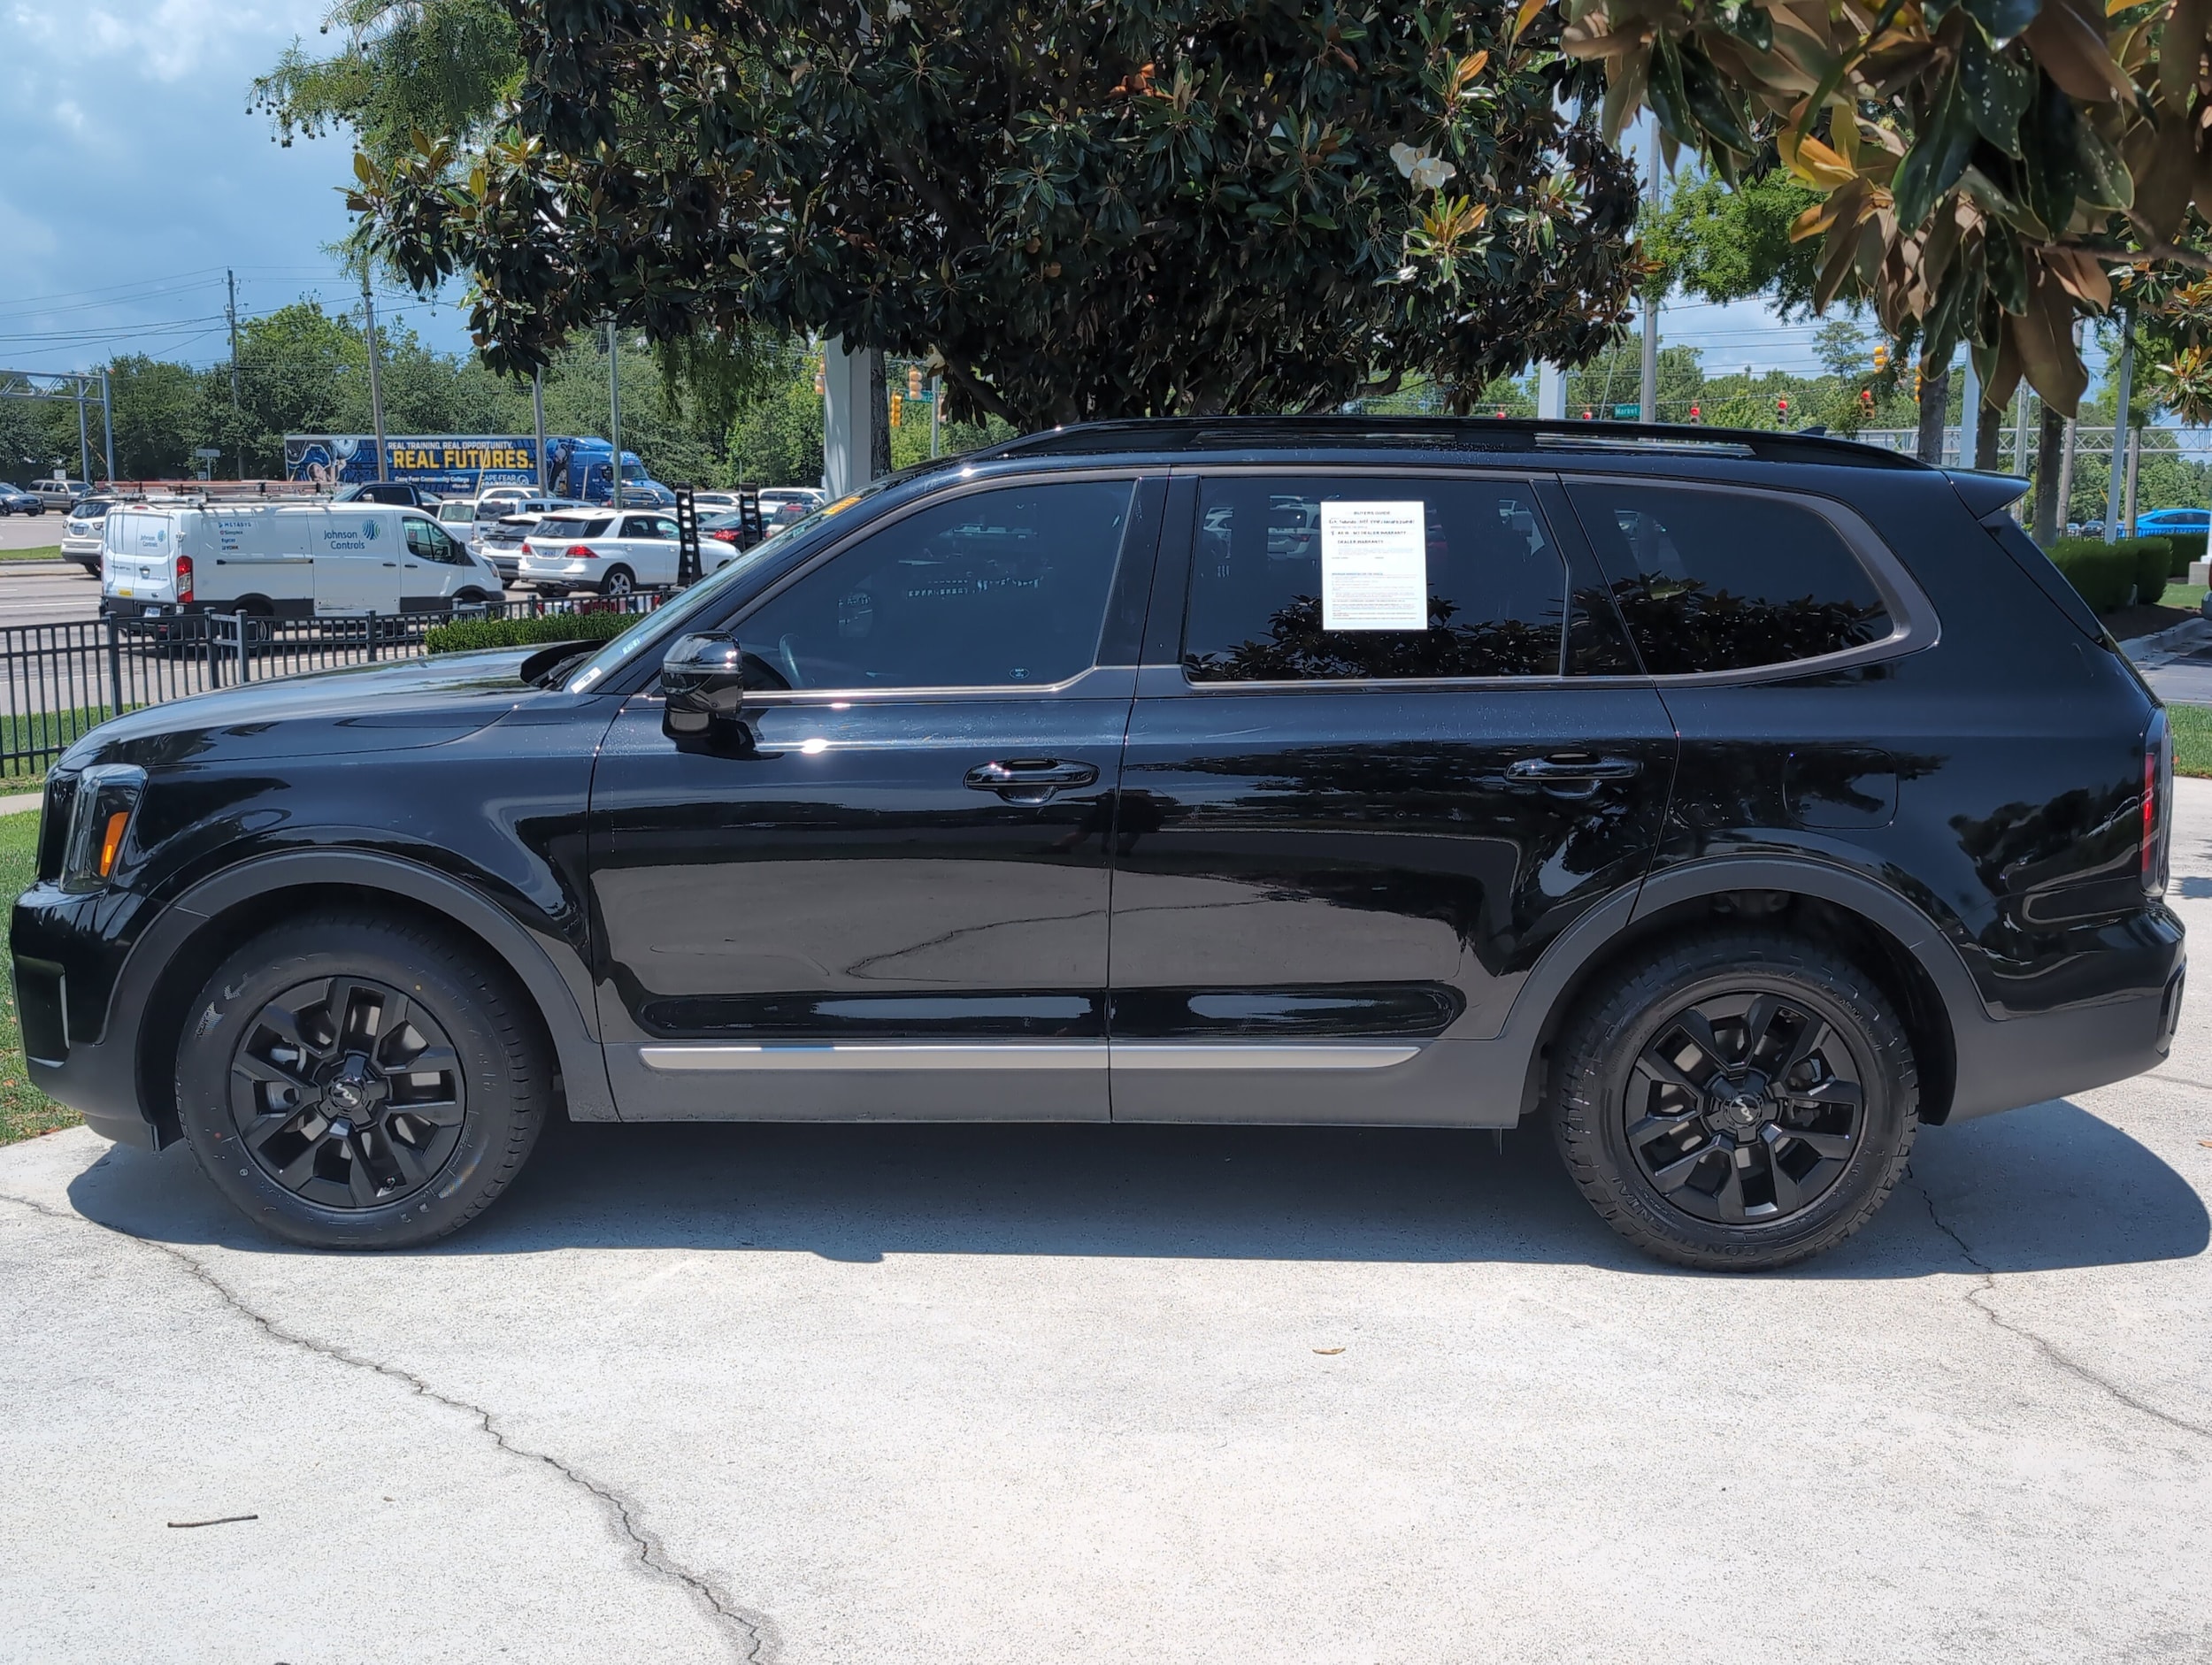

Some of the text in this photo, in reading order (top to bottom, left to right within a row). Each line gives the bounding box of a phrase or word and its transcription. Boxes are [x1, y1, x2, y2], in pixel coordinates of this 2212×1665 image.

[388, 441, 406, 450] REAL
[462, 441, 514, 449] OPPORTUNITY.
[393, 449, 534, 469] REAL FUTURES.
[324, 530, 357, 541] Johnson
[330, 540, 365, 549] Controls
